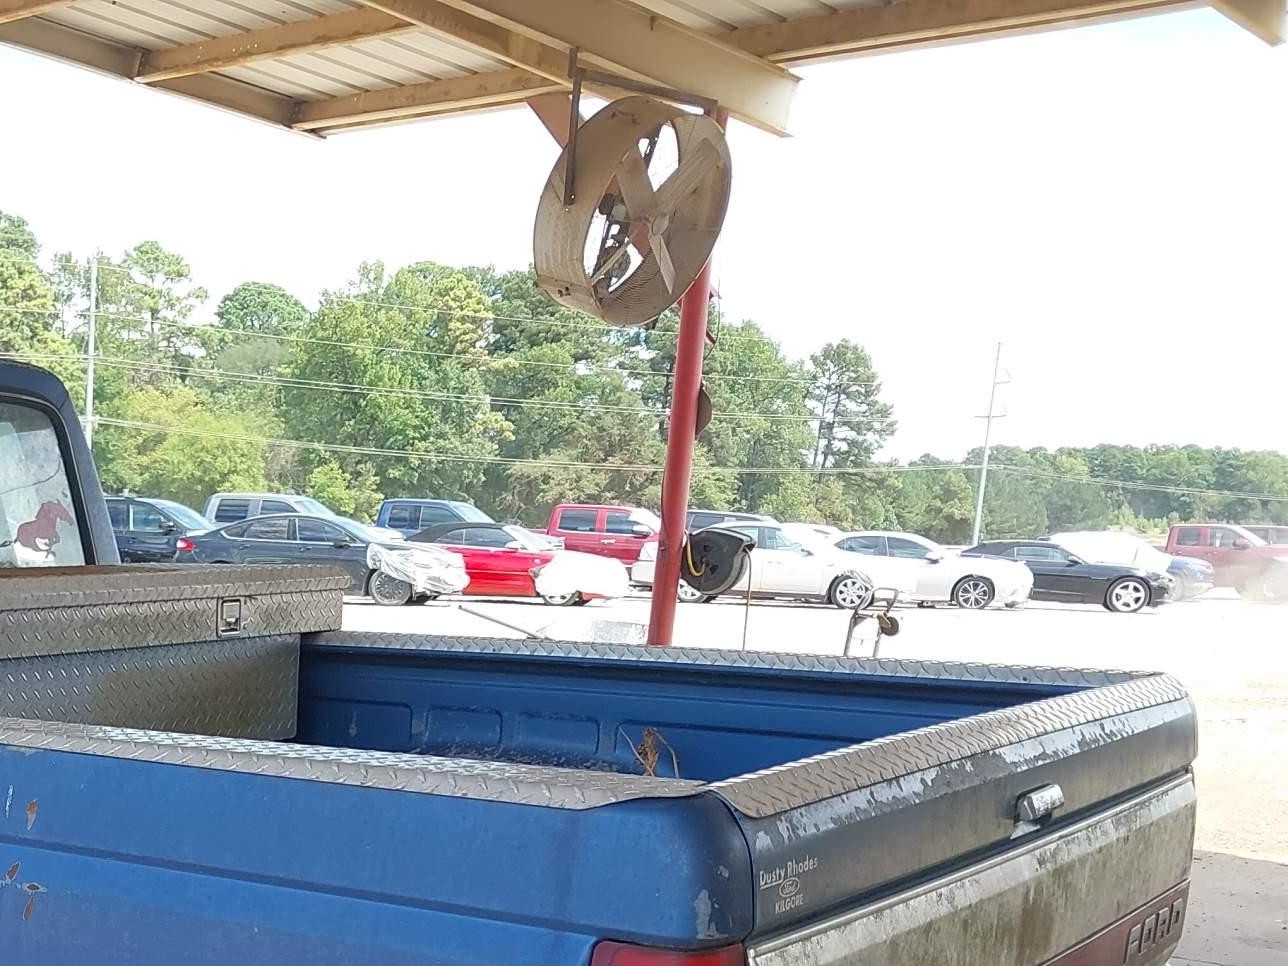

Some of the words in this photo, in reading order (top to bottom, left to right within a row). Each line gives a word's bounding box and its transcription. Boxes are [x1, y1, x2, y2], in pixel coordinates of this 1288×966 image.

[760, 867, 785, 887] Dusty
[787, 854, 818, 877] Rhodes
[775, 893, 804, 913] KILGORE
[1123, 898, 1183, 966] FORD
